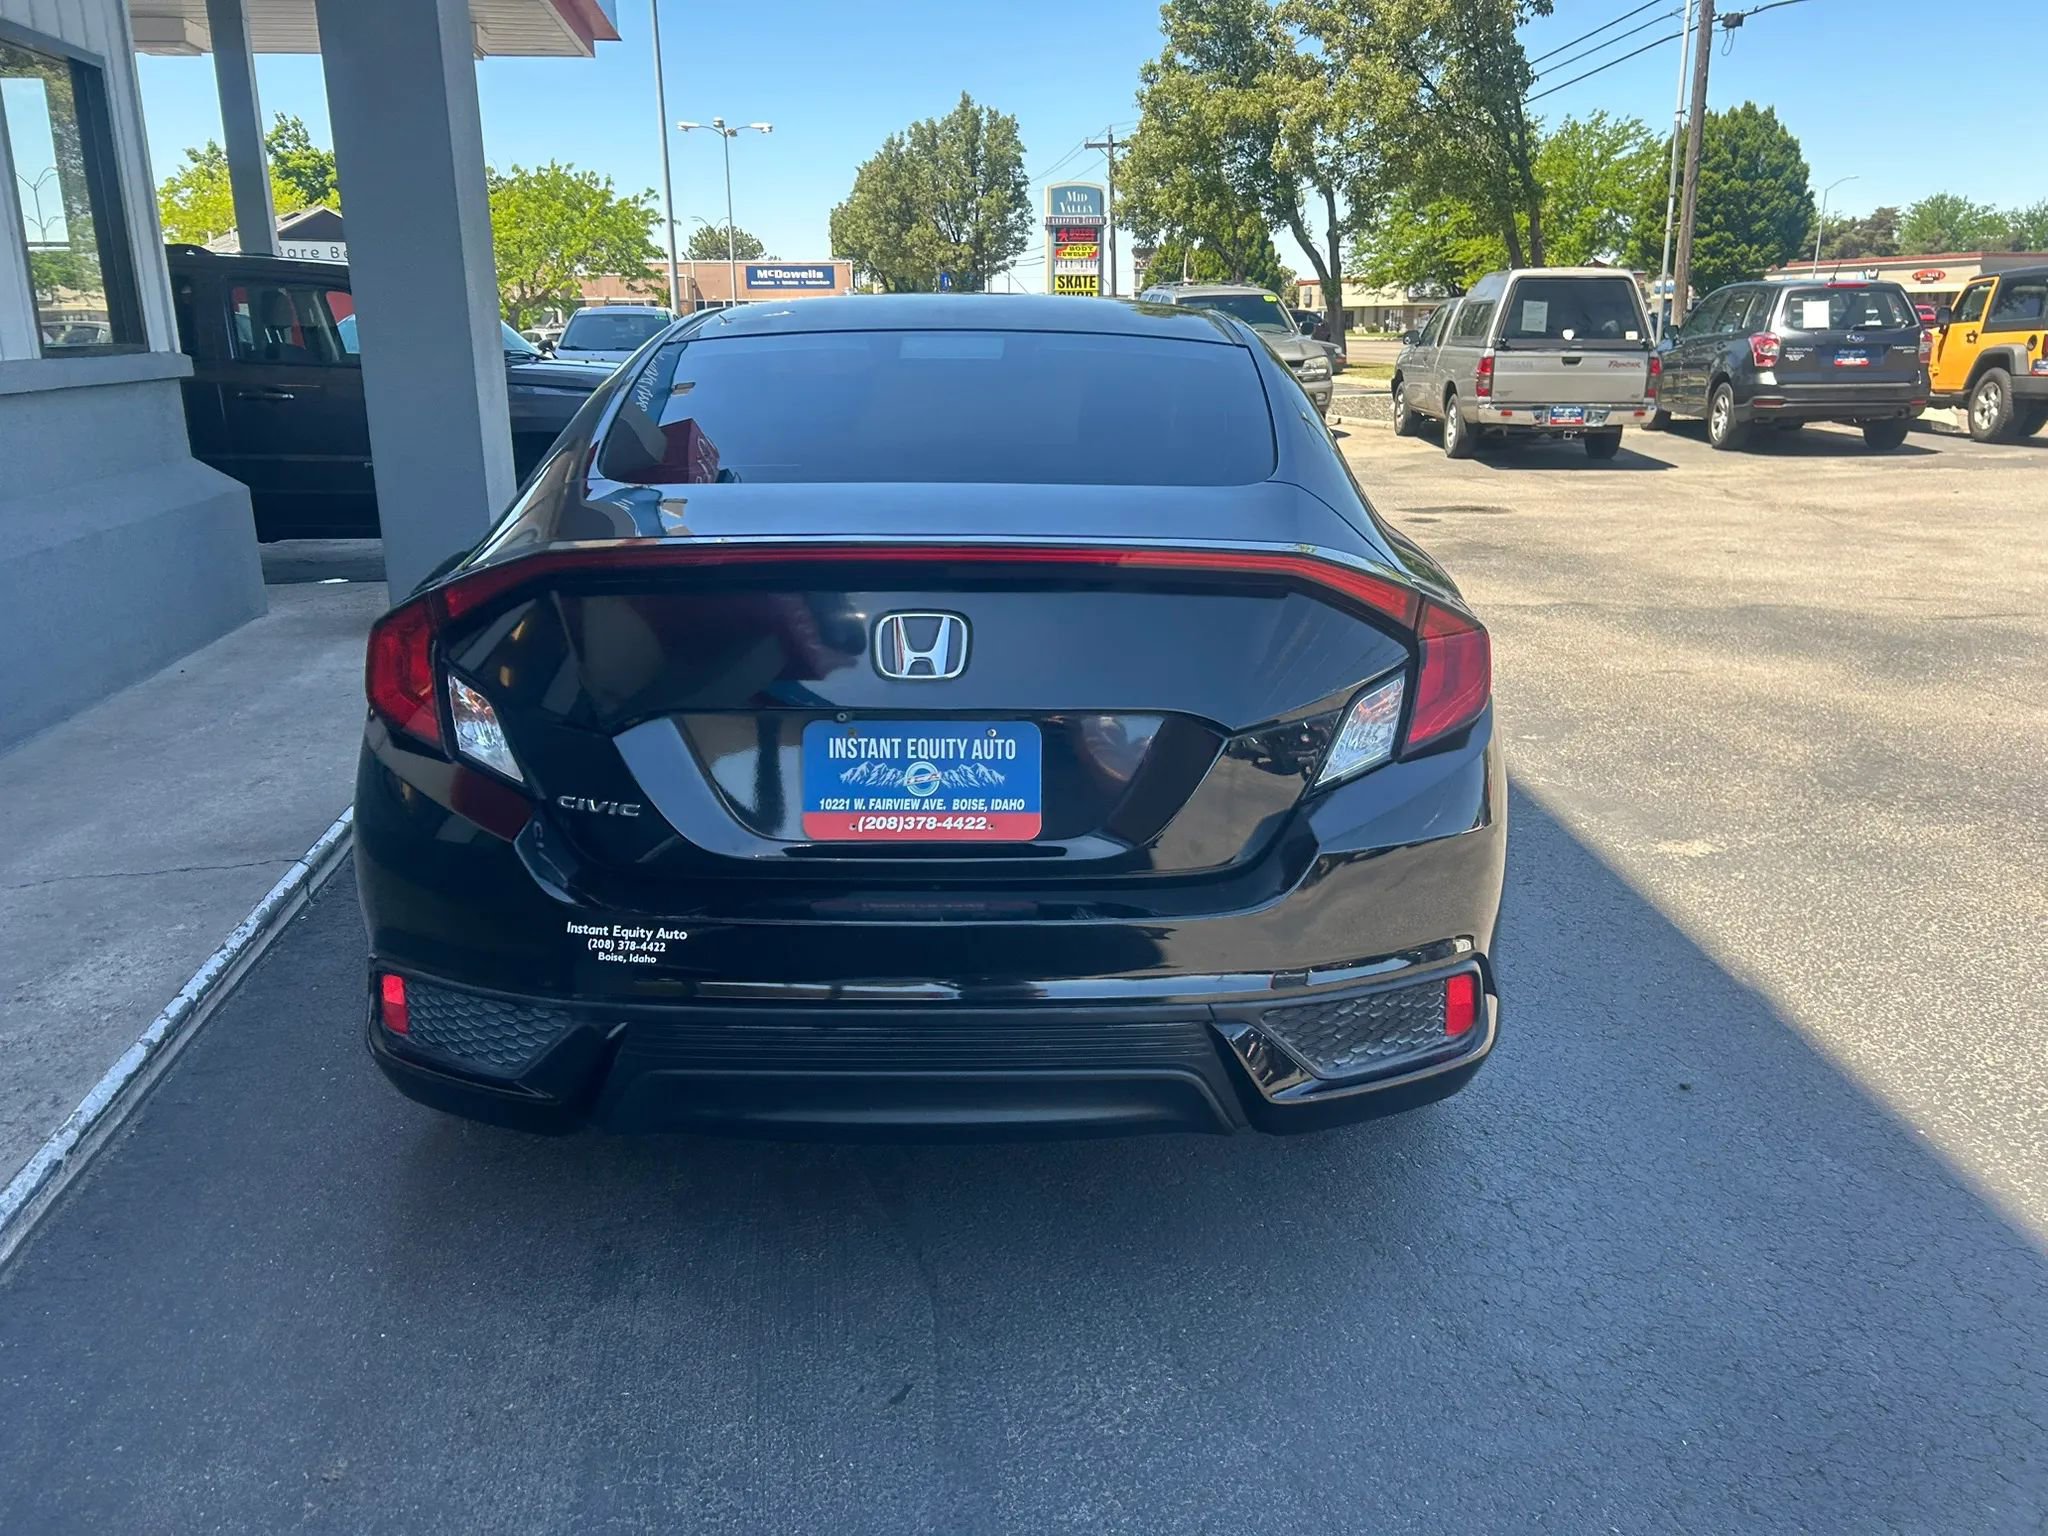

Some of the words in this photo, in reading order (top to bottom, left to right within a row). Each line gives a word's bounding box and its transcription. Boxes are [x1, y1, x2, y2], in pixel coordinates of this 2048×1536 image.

[756, 269, 824, 279] McDowells
[1057, 275, 1096, 289] SKATE
[828, 737, 901, 759] INSTANT
[907, 738, 966, 760] EQUITY
[971, 738, 1016, 760] AUTO
[557, 795, 641, 817] CIVIC
[819, 798, 850, 810] 10221
[853, 799, 866, 810] W.
[868, 798, 922, 811] FAIRVIEW
[922, 798, 946, 810] AVE.
[952, 798, 988, 812] BOISE,
[990, 798, 1025, 811] IDAHO
[857, 816, 987, 832] (208)378-4422
[566, 921, 609, 937] Instant
[612, 925, 654, 941] Equity
[656, 927, 688, 941] Auto
[588, 938, 615, 951] (208)
[617, 939, 666, 953] 378-4422
[598, 951, 627, 963] Boise,
[629, 952, 657, 964] Idaho
